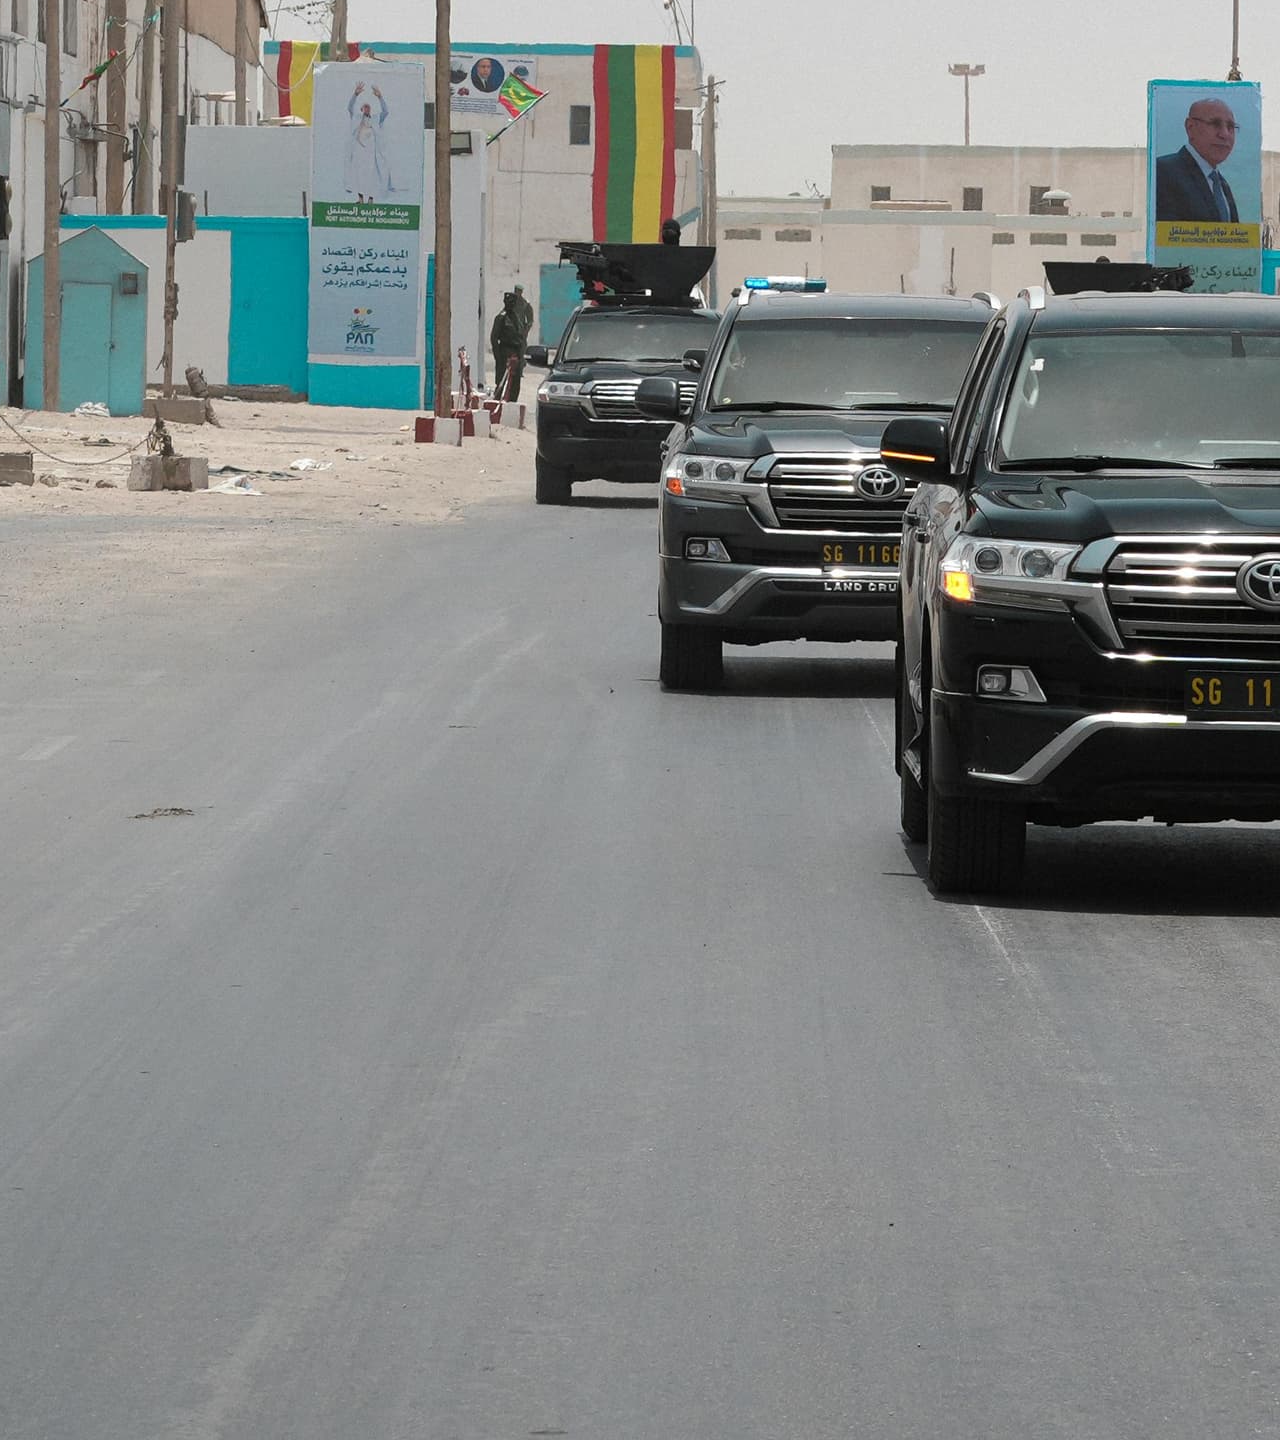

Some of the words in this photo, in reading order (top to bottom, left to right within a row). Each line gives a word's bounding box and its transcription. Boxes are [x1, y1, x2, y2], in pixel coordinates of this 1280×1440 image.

[359, 247, 379, 260] ركن
[381, 248, 408, 260] الميناء
[356, 263, 408, 278] بدعمكم
[1201, 265, 1223, 279] ركن
[823, 544, 843, 562] SG
[824, 582, 862, 592] LAND
[1191, 677, 1222, 705] SG
